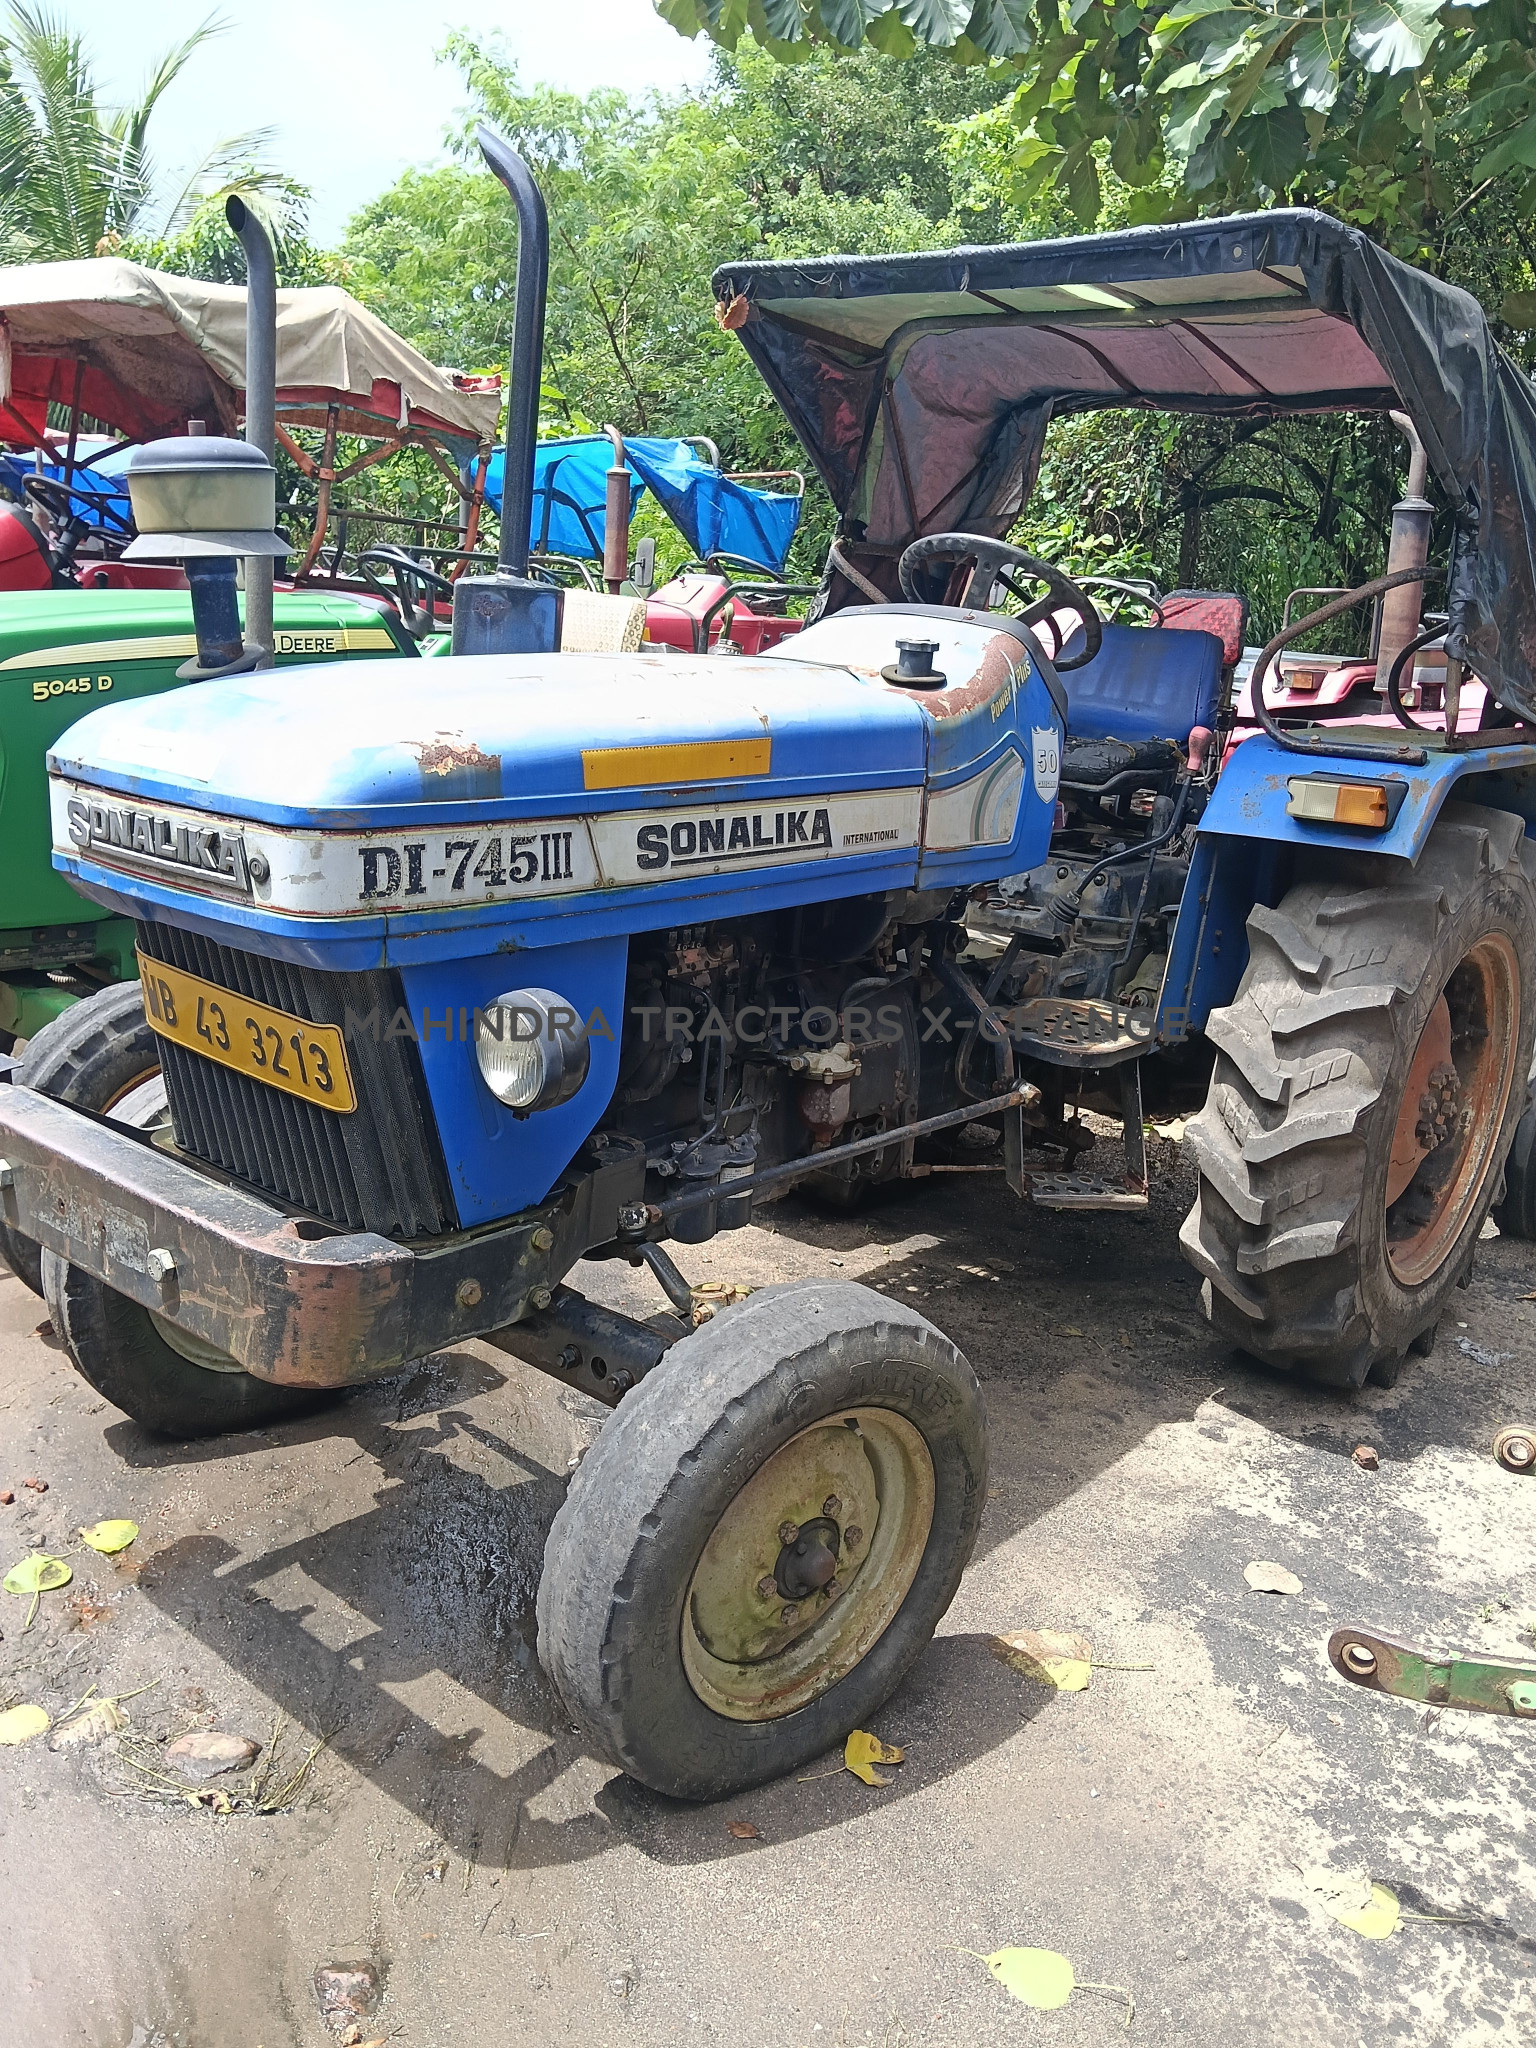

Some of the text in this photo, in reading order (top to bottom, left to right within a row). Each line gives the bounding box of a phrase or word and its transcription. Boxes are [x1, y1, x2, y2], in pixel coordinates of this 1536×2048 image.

[280, 635, 335, 651] DEERE
[32, 675, 113, 701] 5045 D
[991, 659, 1031, 723] Power Plus
[1037, 749, 1057, 774] 50
[67, 795, 253, 888] SONALIKA
[636, 808, 833, 872] SONALIKA
[842, 829, 900, 847] INTERNATIONAL
[196, 996, 232, 1051] 43
[245, 1017, 334, 1093] 3213
